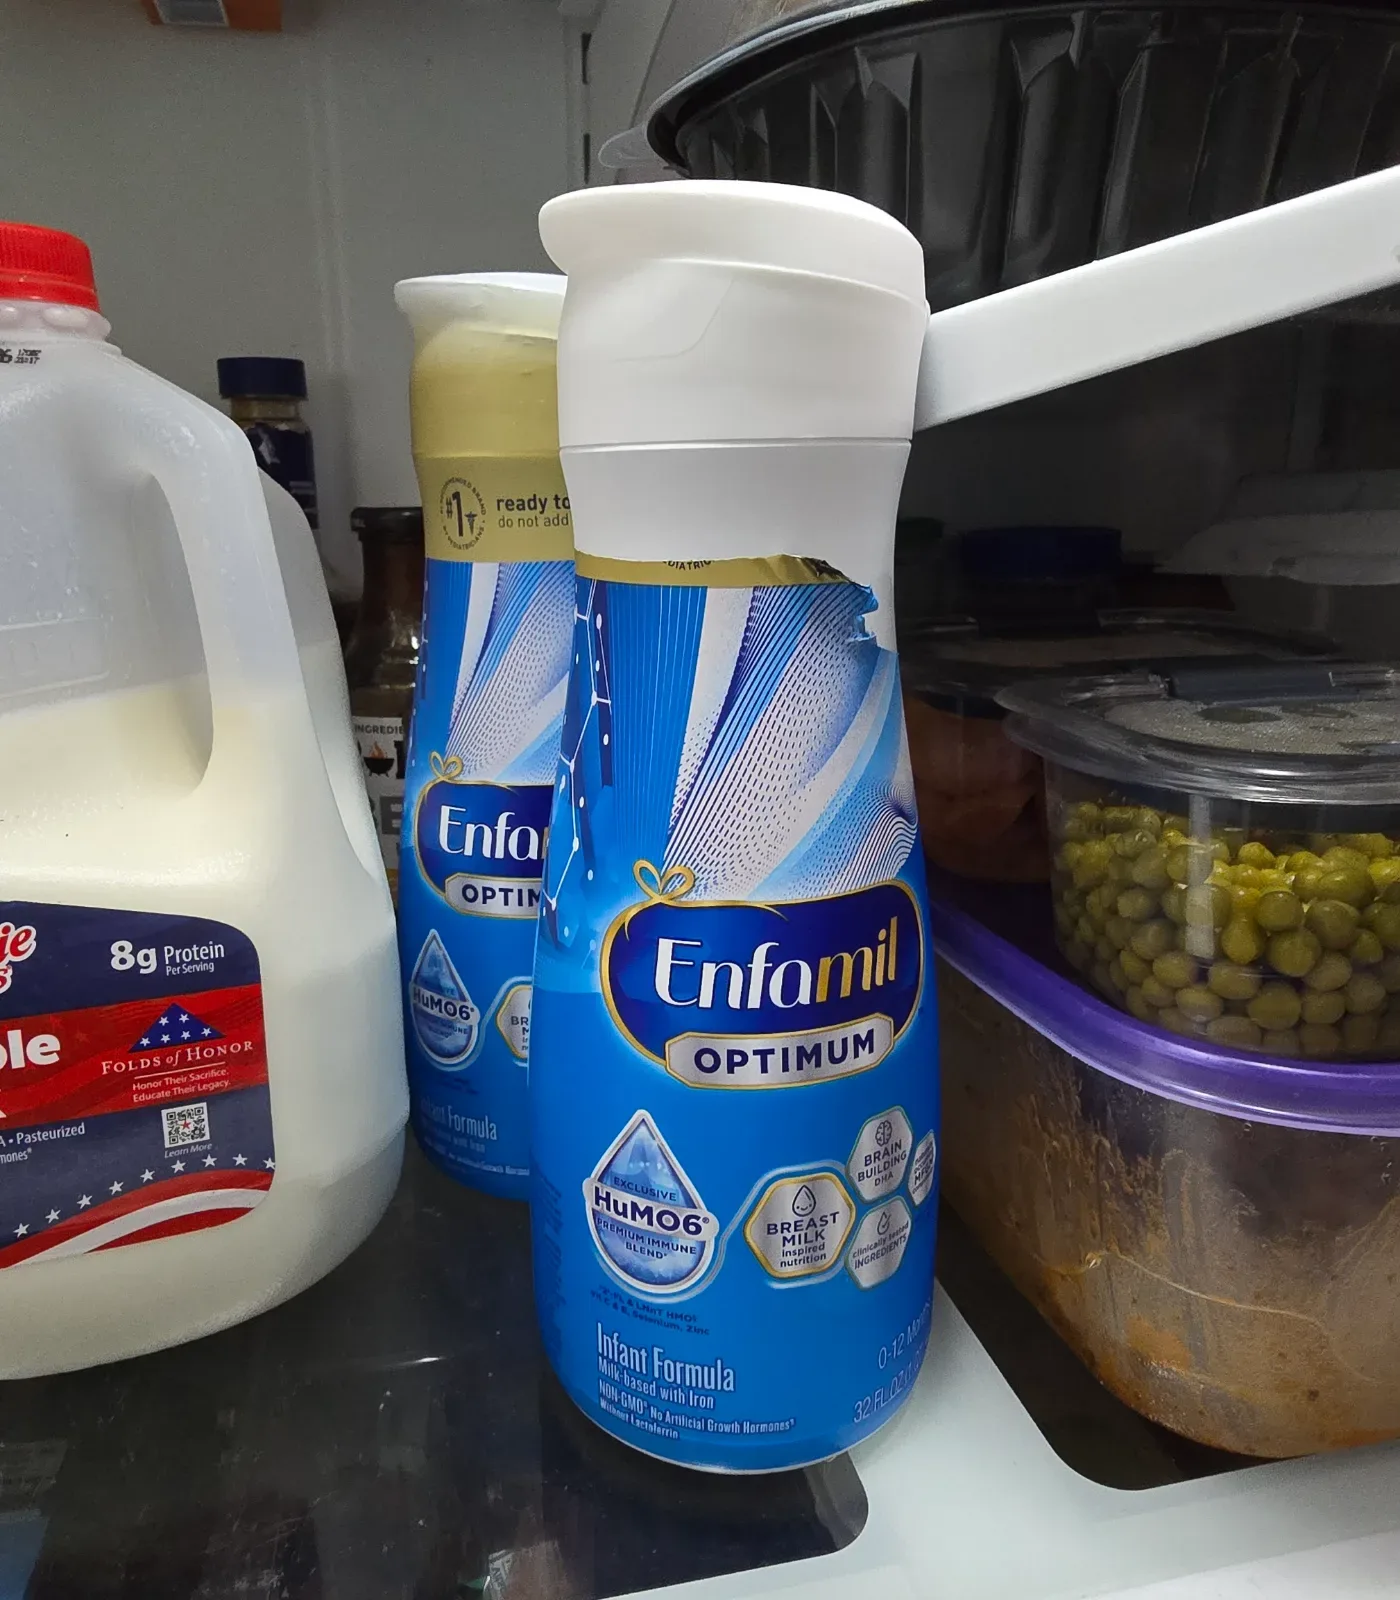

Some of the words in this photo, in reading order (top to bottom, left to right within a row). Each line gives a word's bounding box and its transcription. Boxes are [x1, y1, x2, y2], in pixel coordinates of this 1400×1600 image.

[496, 493, 548, 515] ready
[553, 494, 570, 510] to
[498, 515, 514, 529] do
[518, 515, 539, 528] not
[544, 513, 569, 527] add
[110, 940, 157, 975] 8g
[164, 941, 225, 965] Protein
[166, 964, 180, 976] Per
[182, 961, 215, 974] Serving
[654, 916, 898, 1010] Enfamil
[101, 1053, 161, 1075] FOLDS
[166, 1050, 181, 1067] of
[187, 1041, 254, 1062] HONOR
[694, 1028, 875, 1075] OPTIMUM
[132, 1079, 162, 1092] Honor
[164, 1074, 188, 1087] Their
[189, 1069, 230, 1082] Sacrifice.
[133, 1089, 171, 1103] Educate
[172, 1084, 196, 1096] Their
[197, 1080, 232, 1093] Legacy.
[16, 1122, 86, 1145] Pasteurized
[447, 1104, 498, 1141] Formula
[164, 1147, 189, 1159] Learn
[190, 1143, 213, 1153] More
[864, 1139, 903, 1167] BRAIN
[857, 1151, 907, 1183] BUILDING
[874, 1172, 894, 1187] DHA
[613, 1176, 677, 1202] EXCLUSIVE
[597, 1217, 645, 1244] PREMIUM
[647, 1236, 697, 1255] IMMUNE
[767, 1211, 840, 1236] BREAST
[782, 1228, 826, 1248] MILK
[782, 1242, 826, 1258] inspired
[852, 1233, 887, 1259] clinically
[779, 1252, 827, 1268] nutrition
[854, 1234, 908, 1271] INGREDIENTS
[598, 1321, 648, 1375] Infant
[653, 1347, 736, 1392] Formula
[878, 1332, 905, 1370] 0-12
[598, 1355, 656, 1397] Milk-based
[660, 1386, 686, 1405] with
[689, 1389, 714, 1409] Iron
[600, 1396, 629, 1423] Without
[853, 1396, 872, 1423] 32
[873, 1386, 888, 1413] FL
[650, 1405, 663, 1421] No
[665, 1410, 705, 1431] Artificial
[707, 1418, 741, 1434] Growth
